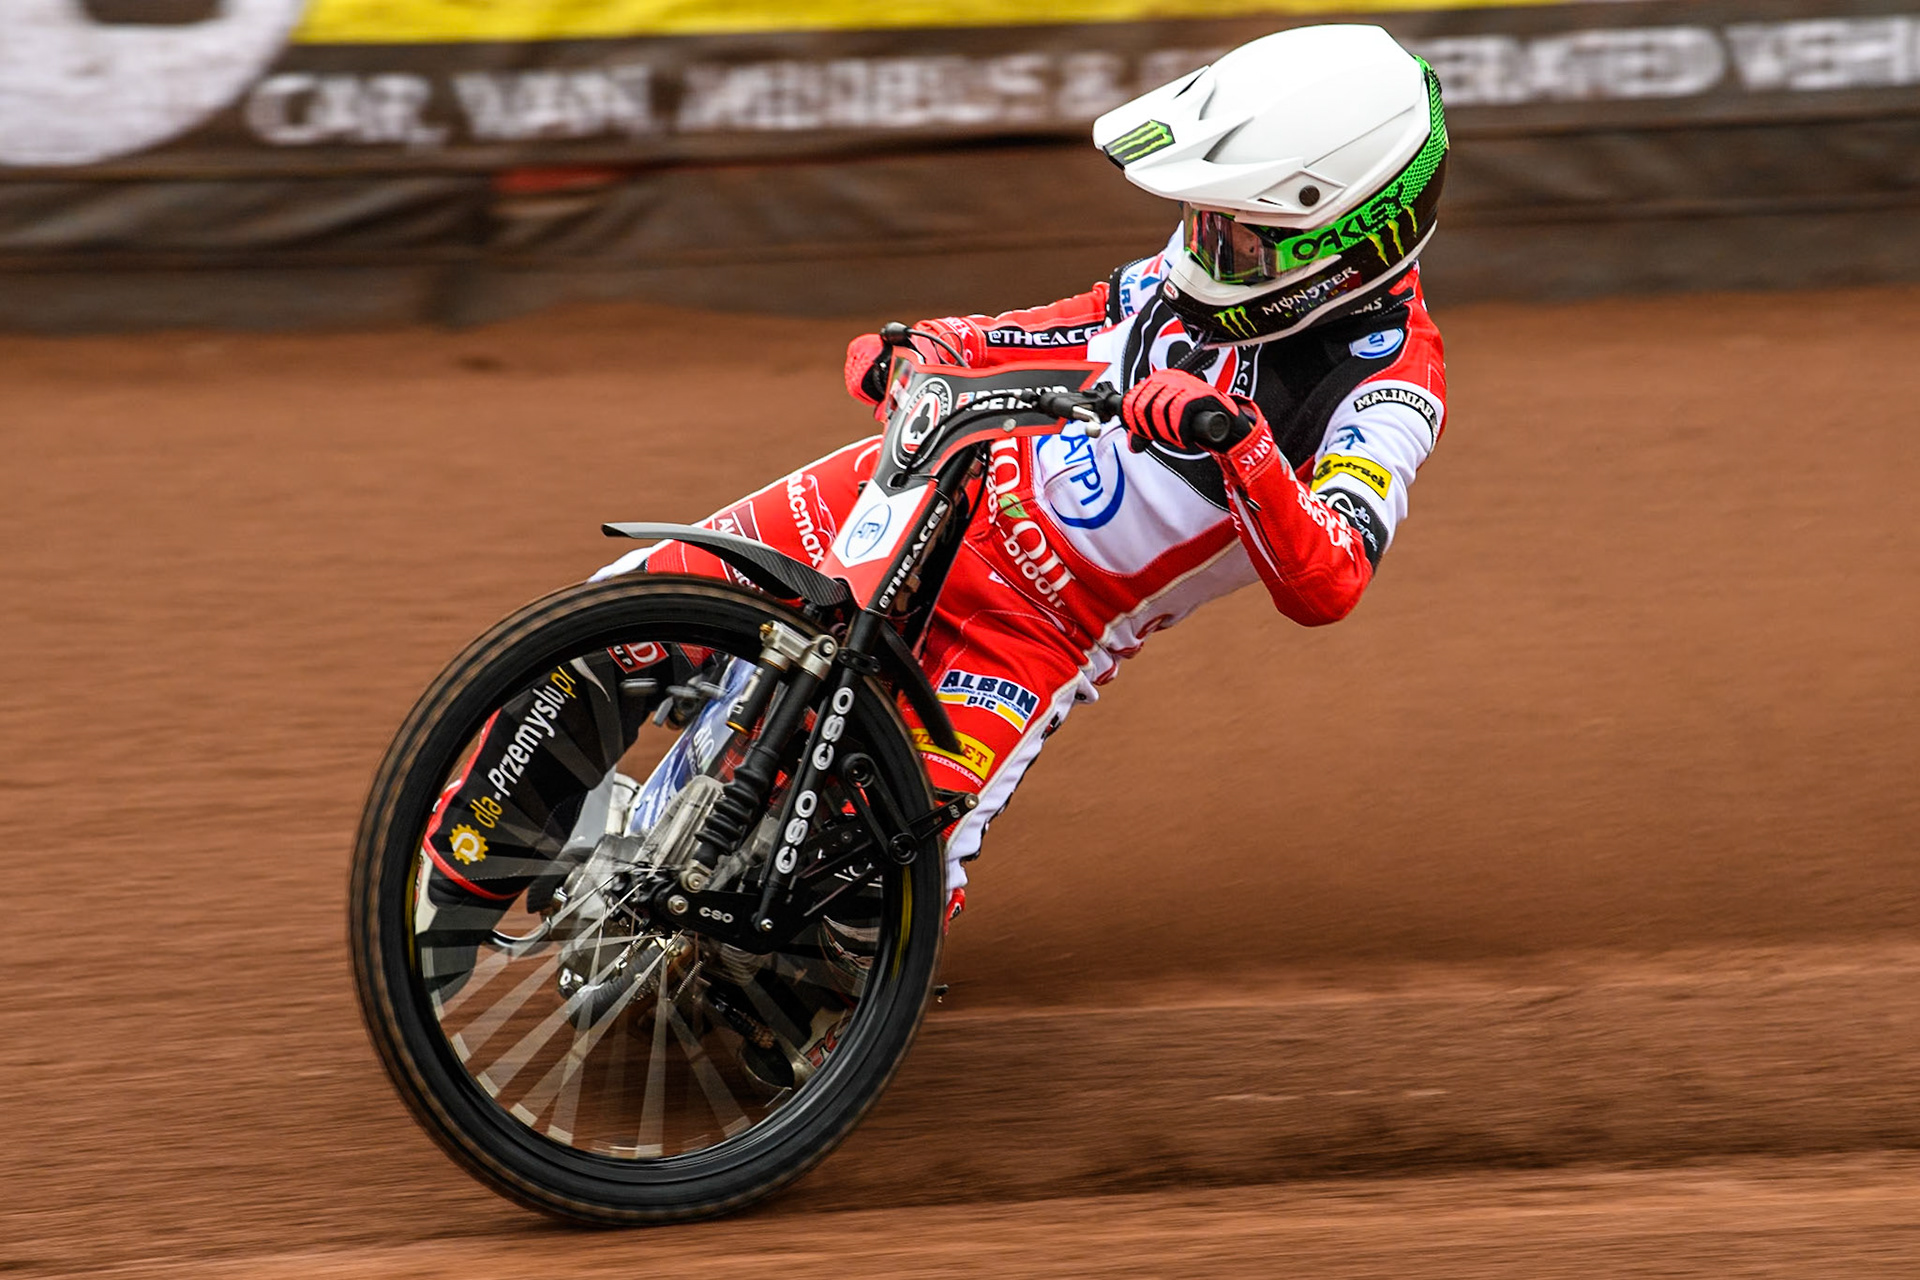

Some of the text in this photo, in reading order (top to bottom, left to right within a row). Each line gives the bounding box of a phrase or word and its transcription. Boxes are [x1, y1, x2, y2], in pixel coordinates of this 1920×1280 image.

[1291, 180, 1404, 261] OAKLEY
[1060, 434, 1104, 506] ATPI
[812, 686, 855, 771] CSO
[942, 671, 1037, 715] ALBON
[775, 789, 818, 885] CSO
[699, 905, 734, 924] CSO
